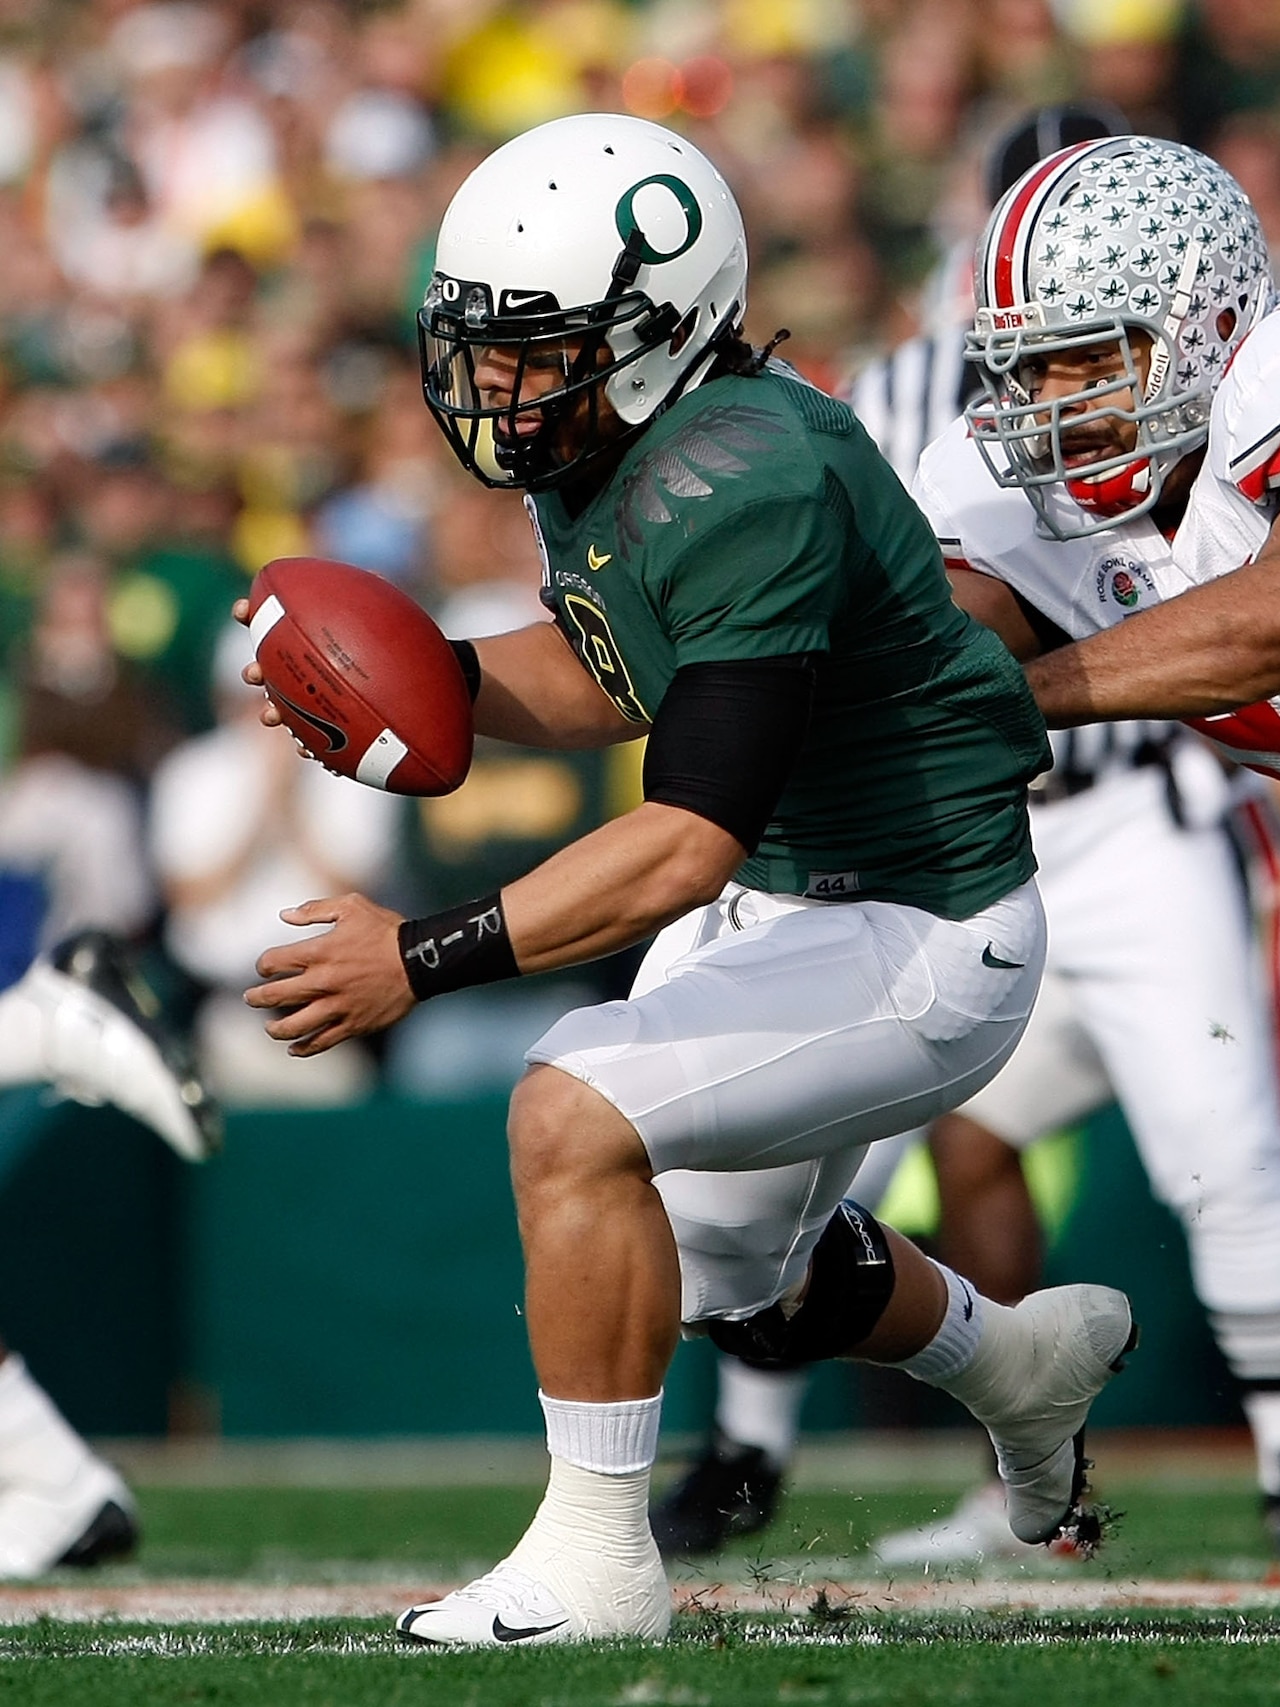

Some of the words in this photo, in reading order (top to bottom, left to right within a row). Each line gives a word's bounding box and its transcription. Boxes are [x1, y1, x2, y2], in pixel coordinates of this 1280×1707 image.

[615, 173, 702, 265] O
[1101, 557, 1127, 573] BOWL
[1128, 561, 1156, 591] GAME
[1096, 570, 1107, 602] ROSE
[815, 876, 845, 894] 44
